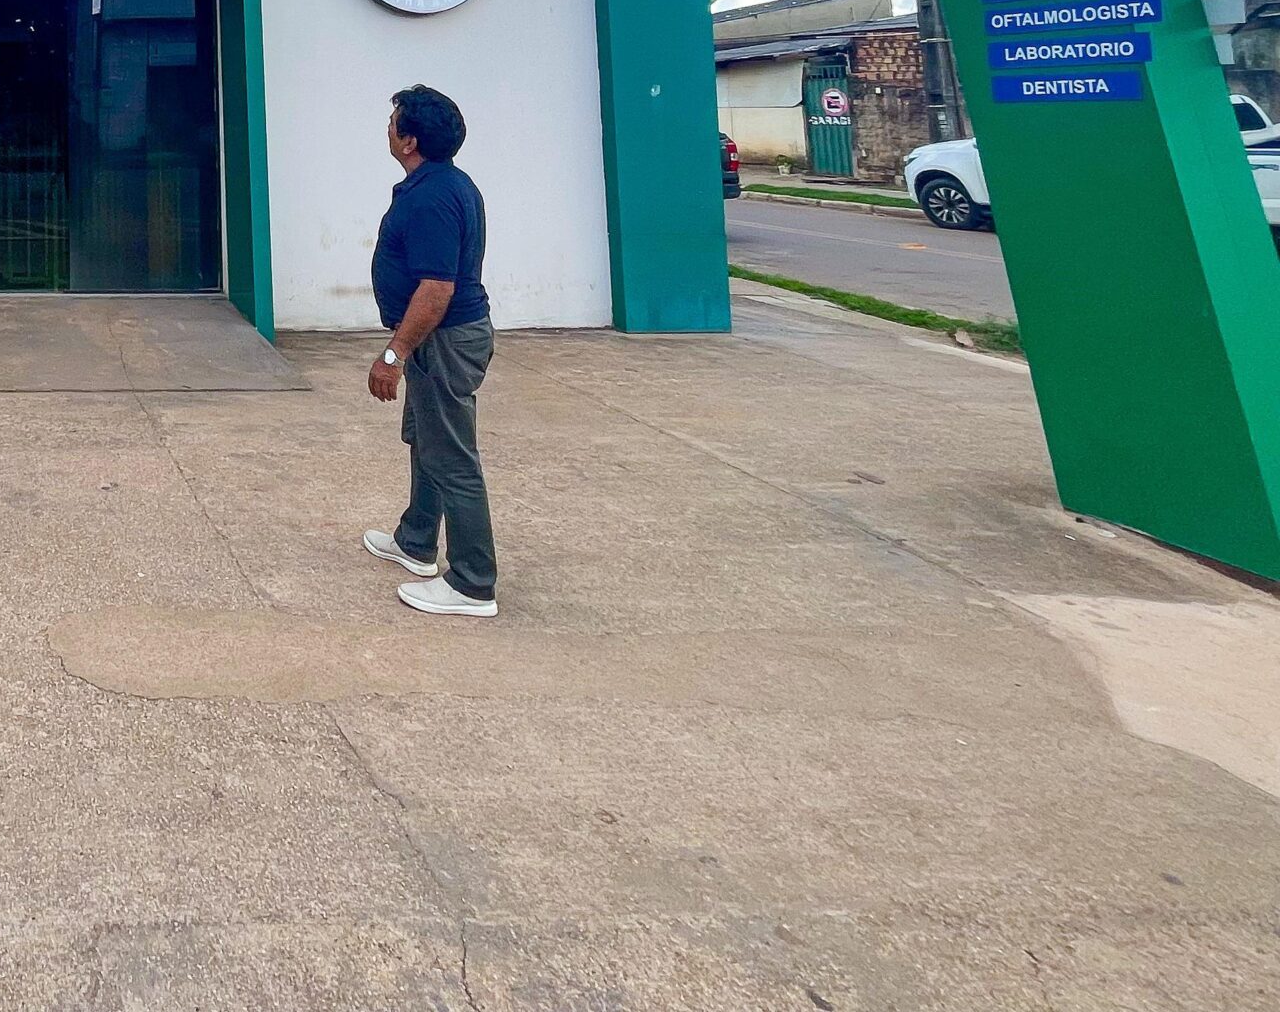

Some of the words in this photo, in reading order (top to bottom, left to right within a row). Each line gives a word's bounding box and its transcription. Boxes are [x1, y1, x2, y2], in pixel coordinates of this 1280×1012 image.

[990, 1, 1156, 29] OFTALMOLOGISTA
[1004, 40, 1135, 62] LABORATORIO
[1022, 78, 1110, 96] DENTISTA
